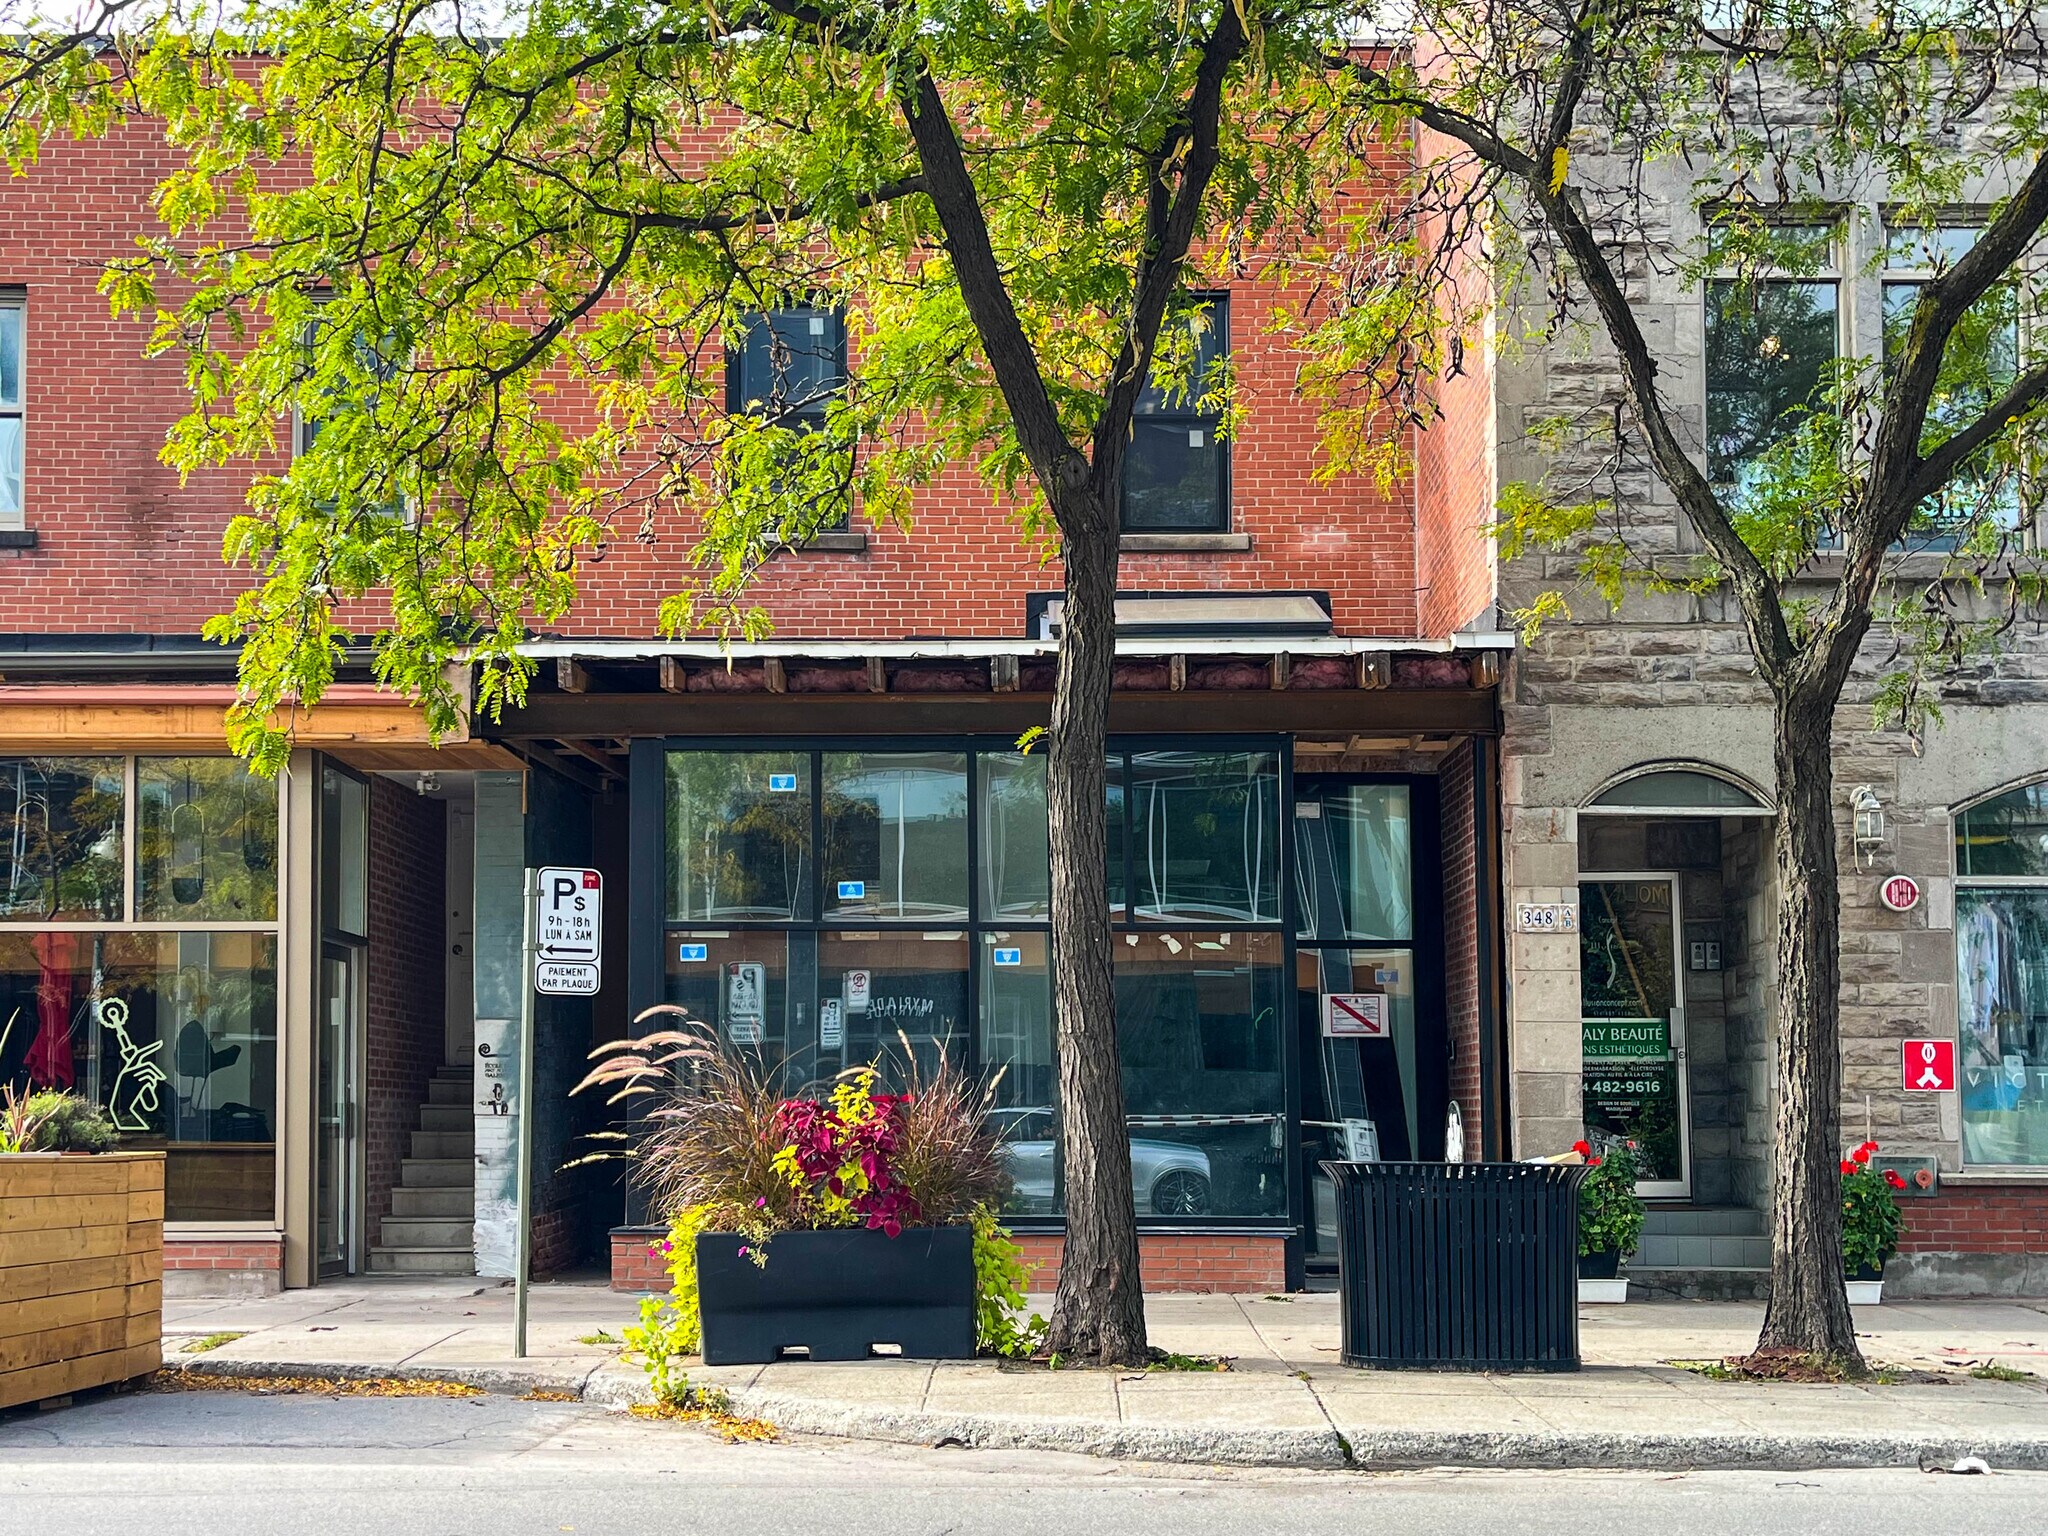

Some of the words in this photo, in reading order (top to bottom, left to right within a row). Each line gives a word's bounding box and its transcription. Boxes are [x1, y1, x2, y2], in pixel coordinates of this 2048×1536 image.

[553, 878, 577, 910] P
[1524, 911, 1553, 925] 348
[545, 929, 562, 940] LUN
[566, 929, 571, 940] À
[575, 930, 592, 941] SAM
[548, 966, 588, 977] PAIEMENT
[542, 978, 558, 988] PAR
[561, 979, 593, 989] PLAQUE
[1583, 1028, 1606, 1041] ALY
[1611, 1024, 1663, 1041] BEAUTÉ
[1600, 1043, 1661, 1056] ESTHÉTIQUES
[1592, 1081, 1661, 1093] 482-9616
